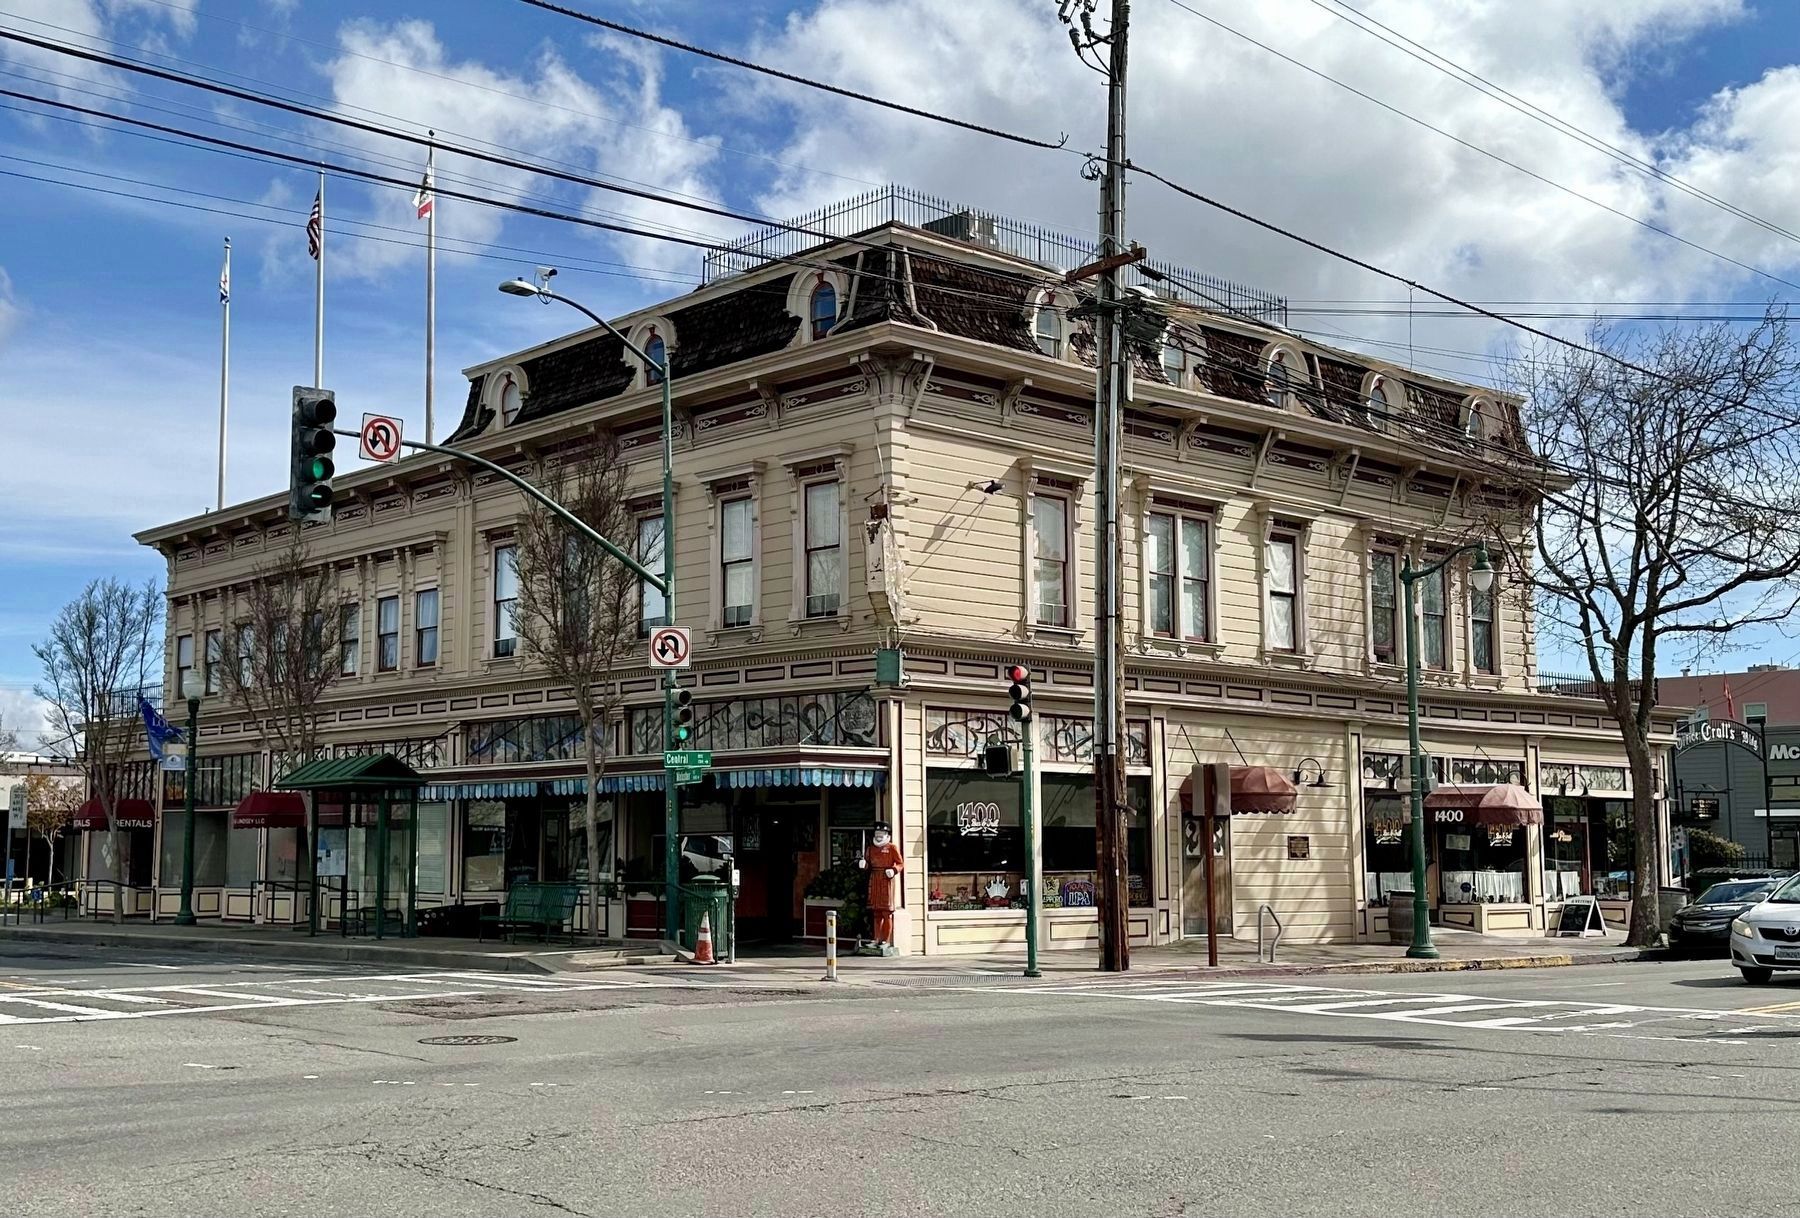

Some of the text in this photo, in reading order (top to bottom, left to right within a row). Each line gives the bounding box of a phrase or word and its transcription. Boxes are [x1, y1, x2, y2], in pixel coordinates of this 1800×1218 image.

[1701, 722, 1736, 741] Croll's
[1741, 731, 1759, 751] Bldg
[666, 753, 689, 764] Central
[957, 801, 1001, 827] 1400
[1434, 809, 1464, 822] 1400
[114, 819, 153, 828] RENTALS
[1067, 891, 1091, 906] IPA
